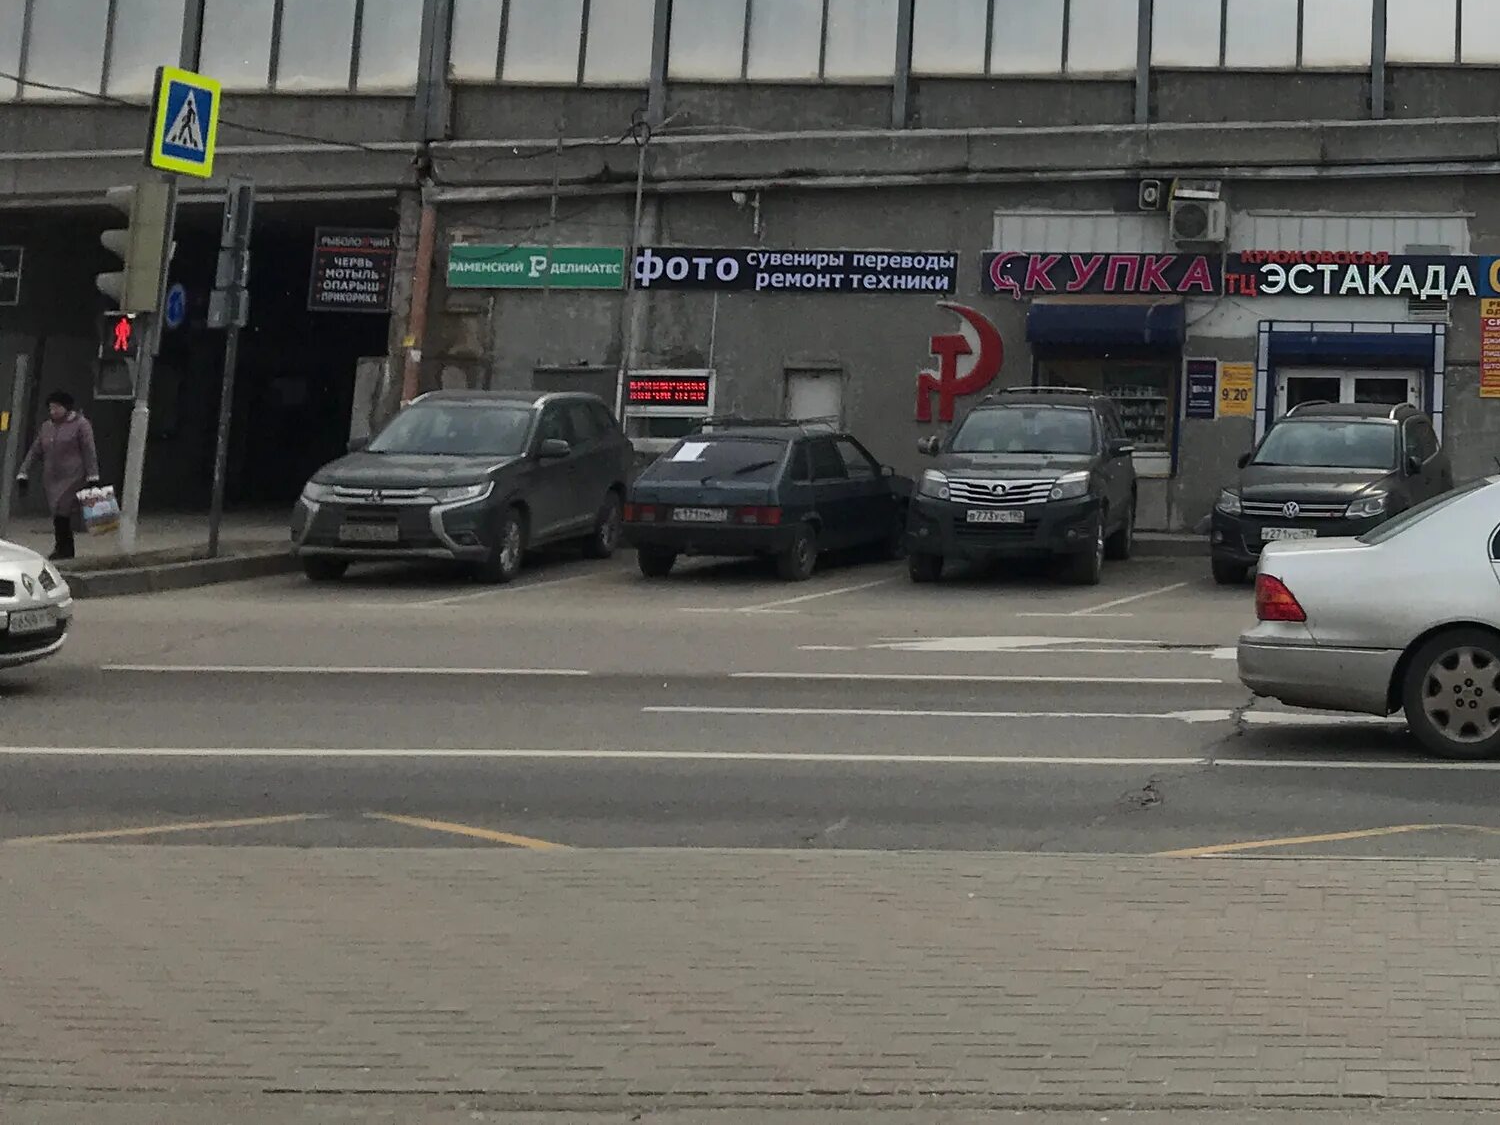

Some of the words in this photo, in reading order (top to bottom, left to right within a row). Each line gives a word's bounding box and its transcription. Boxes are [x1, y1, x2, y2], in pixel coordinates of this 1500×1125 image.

[334, 257, 373, 268] ЧЕРВЬ
[746, 251, 844, 268] сувениры
[852, 253, 955, 270] переводы
[1241, 250, 1390, 264] КРЮКОВСКАЯ
[325, 268, 379, 280] МОТЫЛЬ
[449, 261, 524, 273] РАМЕНСКИЙ
[550, 263, 621, 274] ДЕЛИКАТЕС
[756, 270, 844, 291] ремонт
[849, 272, 949, 290] техники
[990, 251, 1214, 301] СКУПКА
[1225, 273, 1258, 297] ТЦ
[1259, 263, 1476, 300] ЭСТАКАДА
[322, 279, 379, 292] ОПАРЫШ
